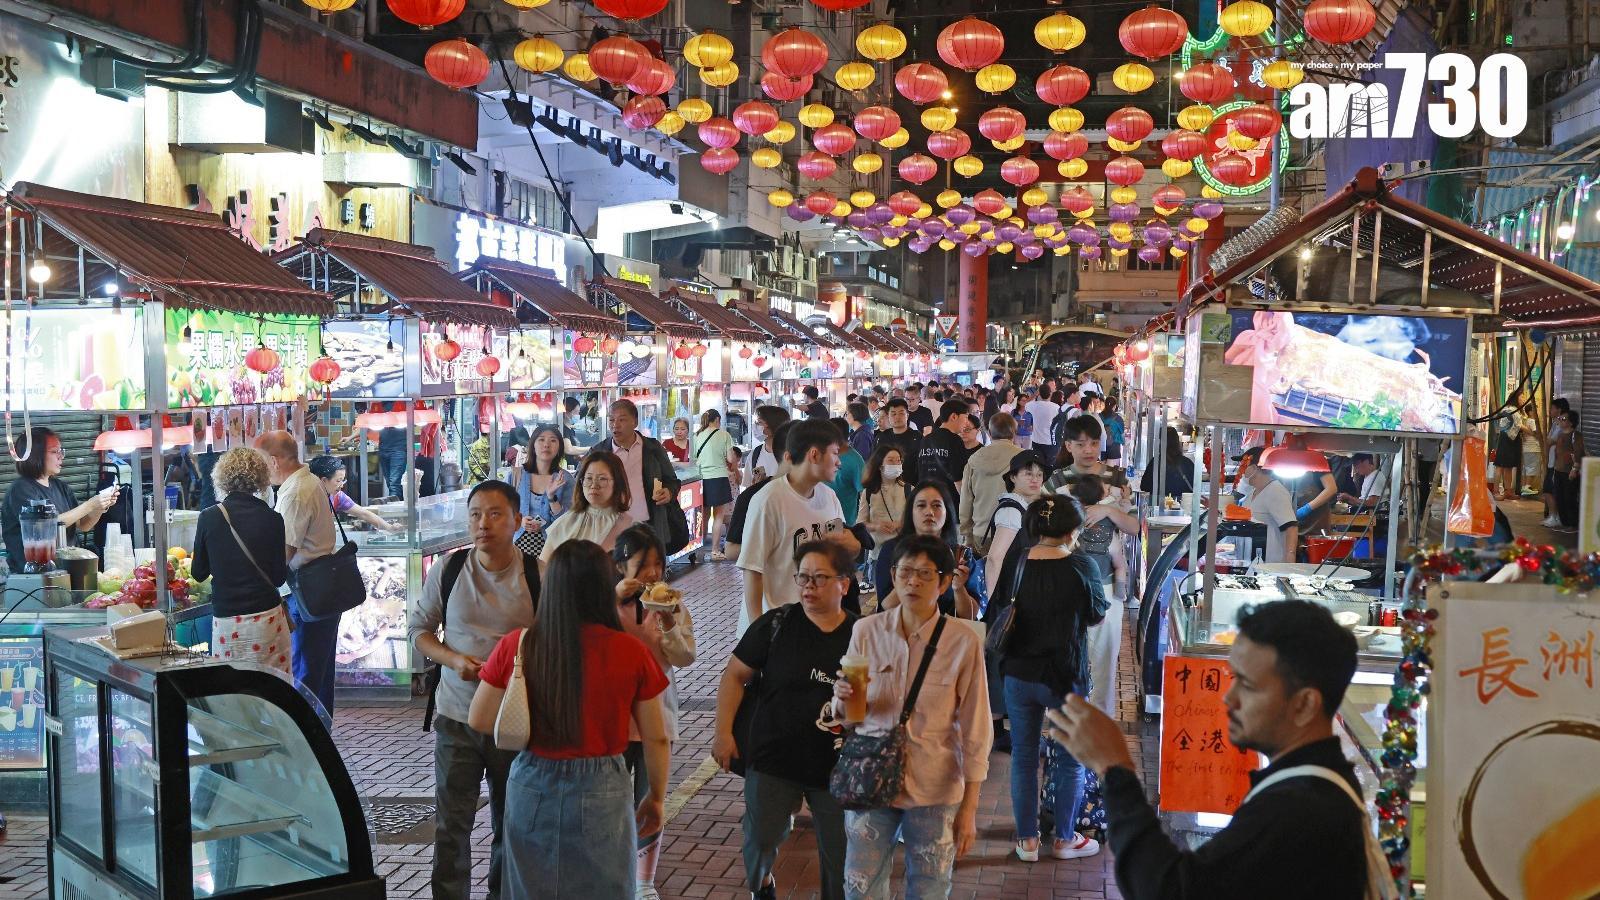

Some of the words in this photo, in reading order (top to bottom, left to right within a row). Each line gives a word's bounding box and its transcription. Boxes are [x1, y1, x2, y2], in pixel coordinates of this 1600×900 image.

[1174, 664, 1234, 694] 中國
[1459, 627, 1595, 704] 長洲
[1172, 728, 1248, 754] 全港
